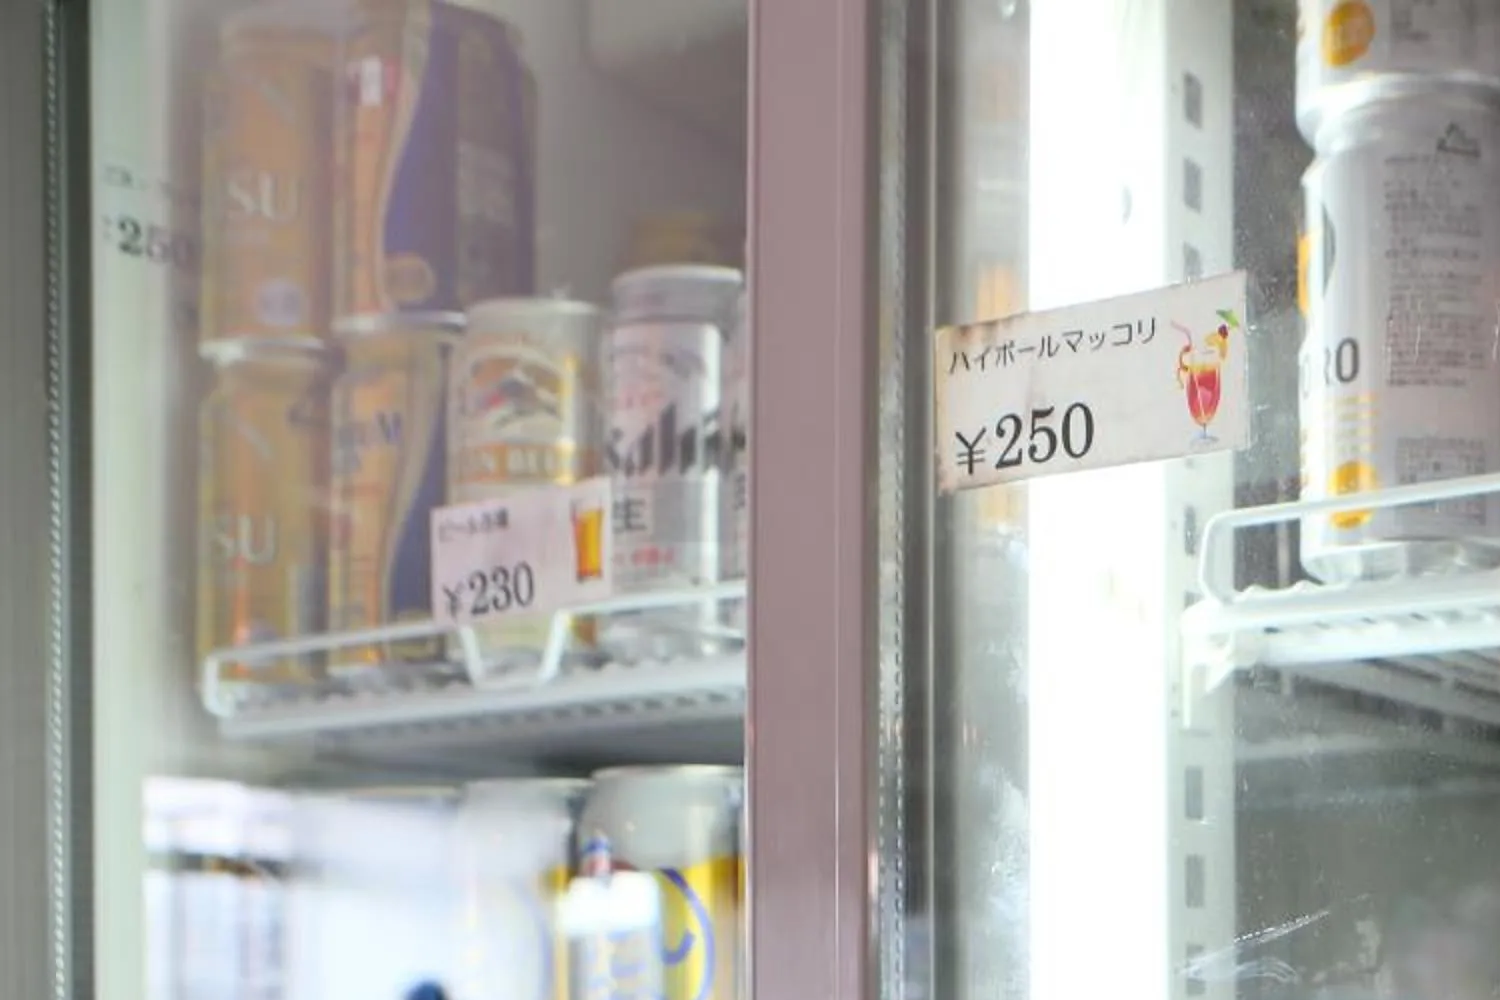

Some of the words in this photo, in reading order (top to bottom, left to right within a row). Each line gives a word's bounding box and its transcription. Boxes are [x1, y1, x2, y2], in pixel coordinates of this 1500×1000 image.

[949, 316, 1156, 374] ハイボールマッコリ
[955, 402, 1095, 475] ¥250
[442, 560, 535, 620] ¥230
